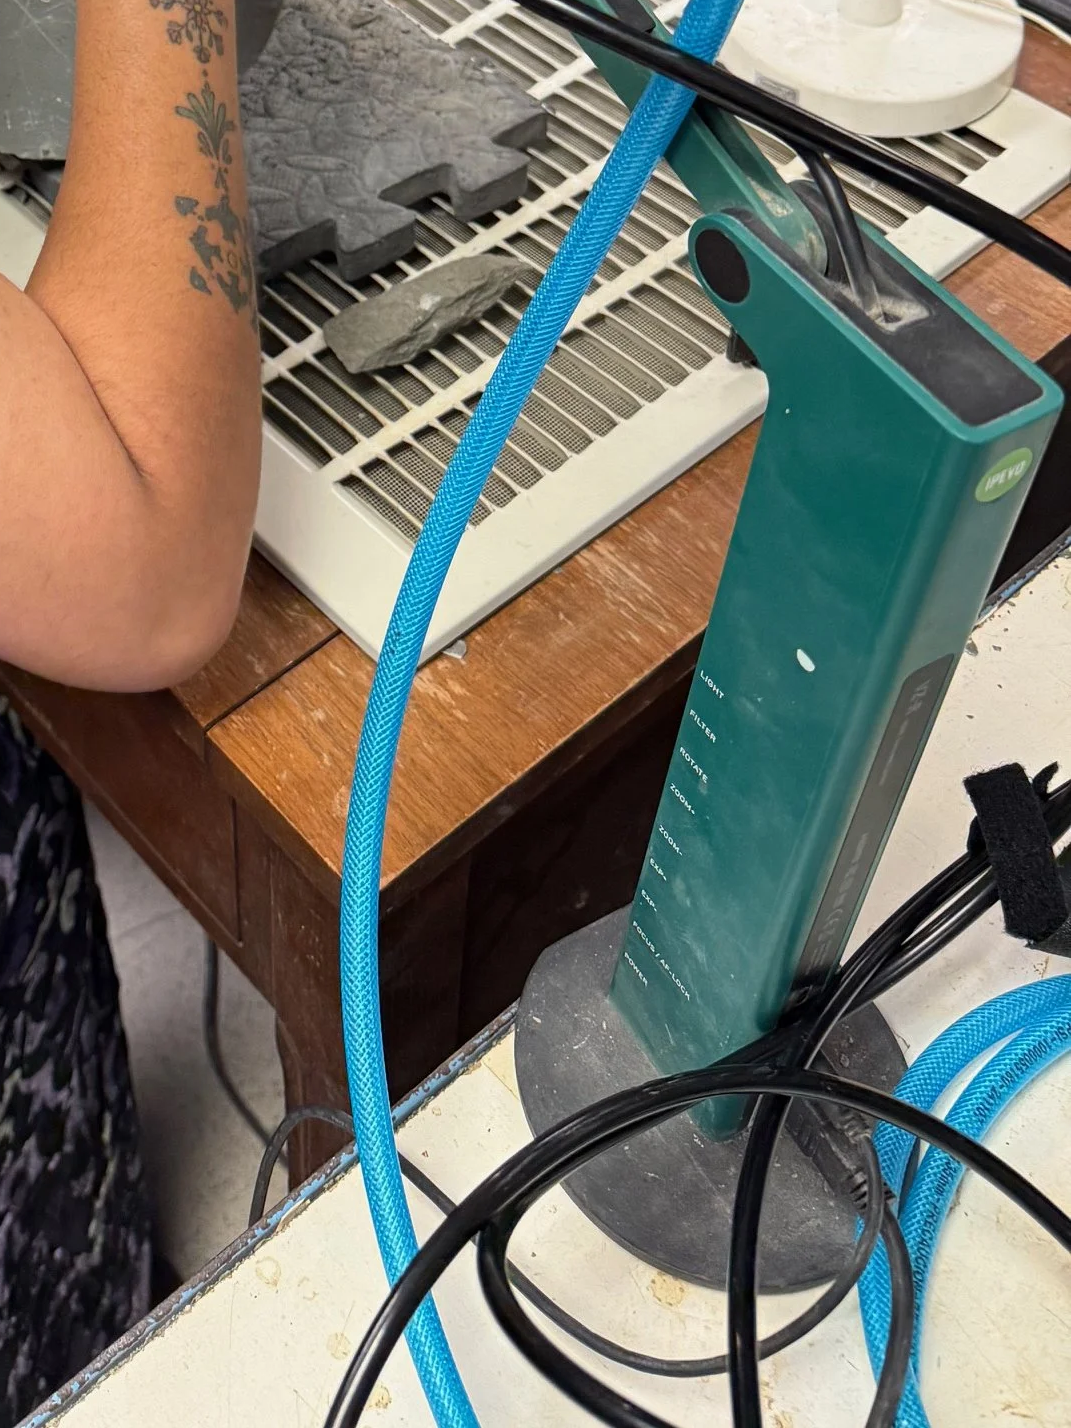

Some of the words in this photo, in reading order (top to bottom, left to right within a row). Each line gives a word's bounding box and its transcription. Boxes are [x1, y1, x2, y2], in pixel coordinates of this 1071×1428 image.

[985, 460, 1026, 492] IPEVO
[700, 670, 724, 699] LIGHT
[689, 709, 717, 743] FILTER
[680, 746, 708, 783] ROTATE
[668, 782, 695, 815] ZOOM+
[658, 824, 683, 856] ZOOM-
[624, 951, 648, 988] POWER
[633, 920, 655, 953] FOCUS
[660, 959, 690, 1001] AF-LOCK
